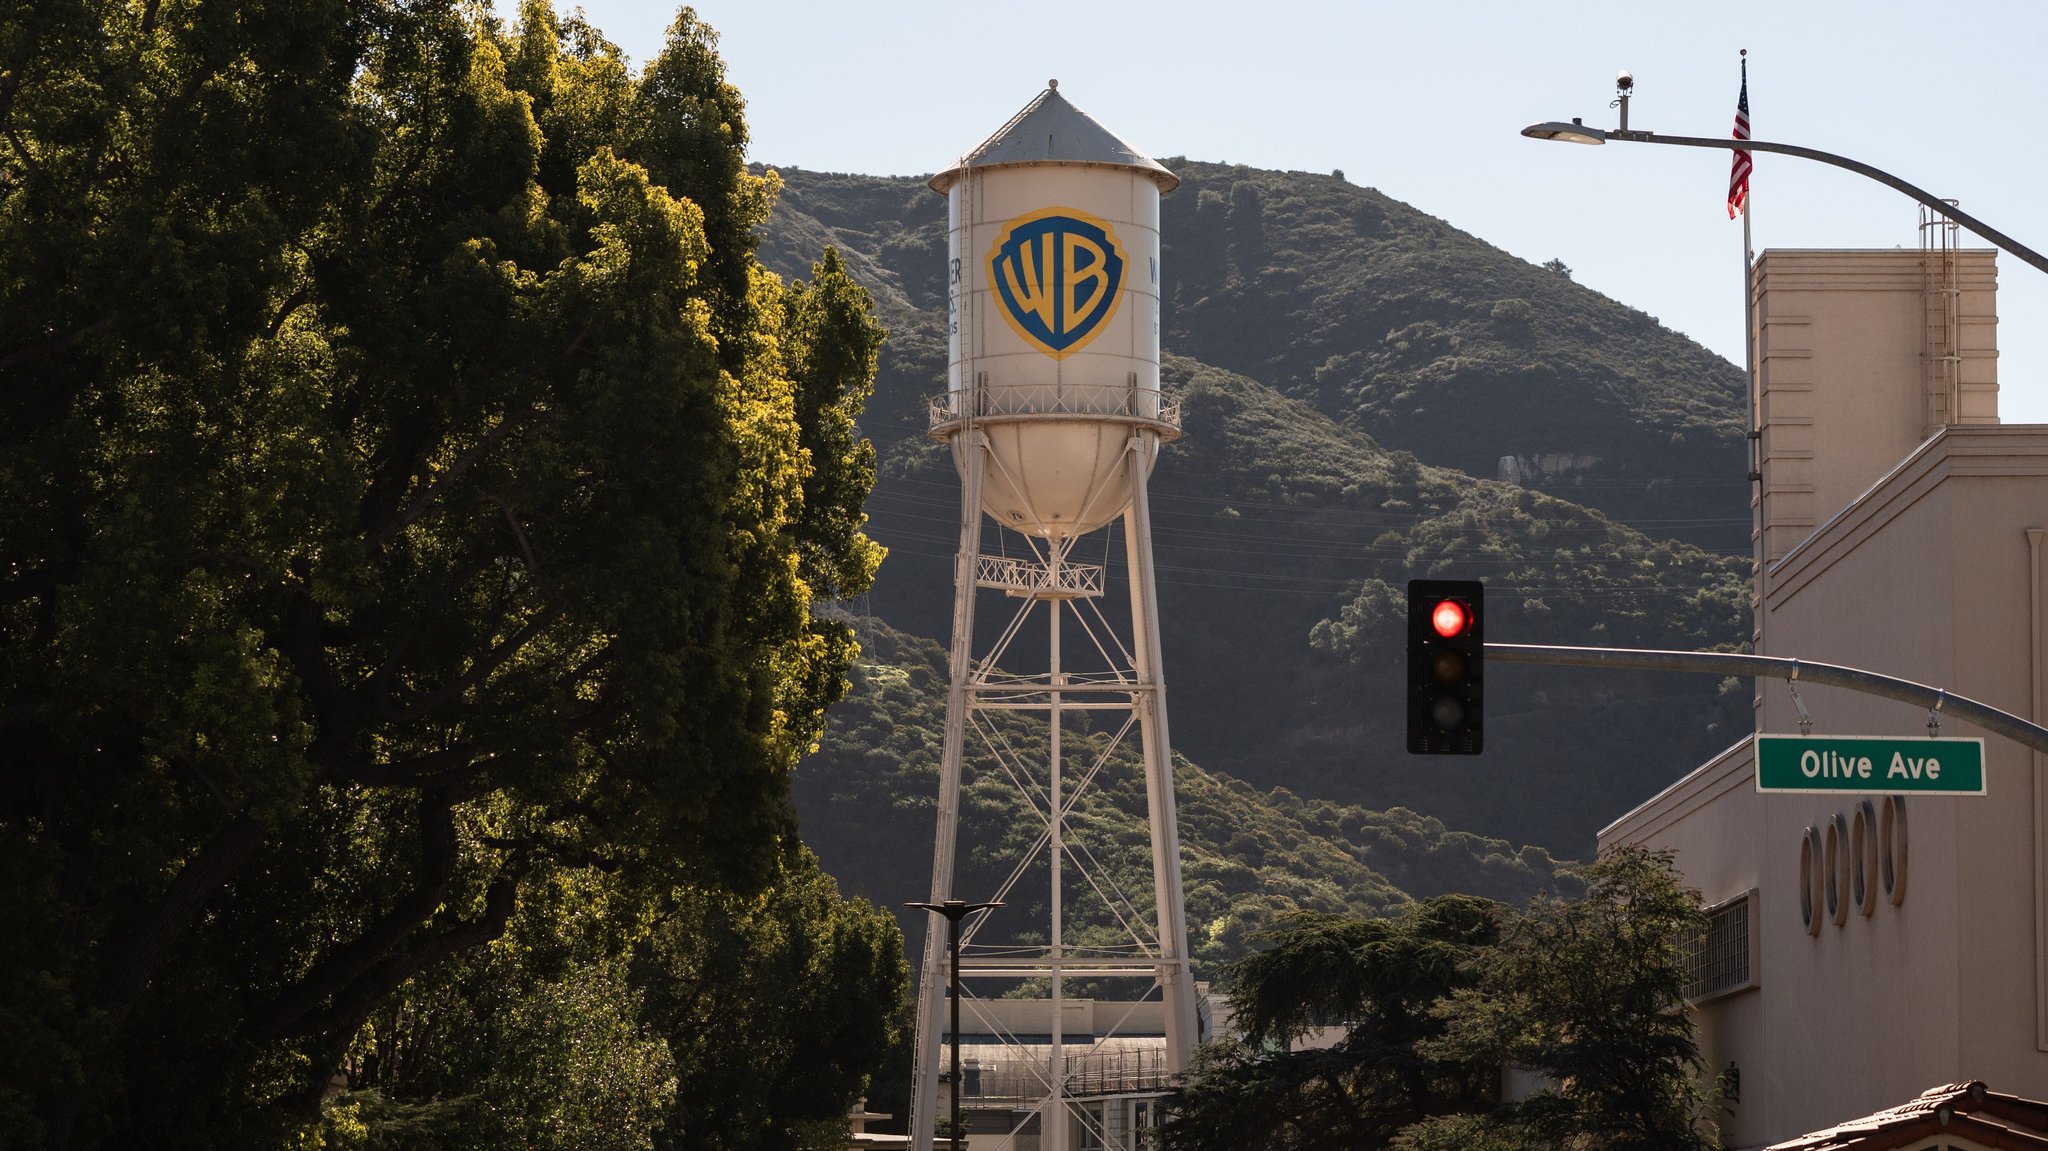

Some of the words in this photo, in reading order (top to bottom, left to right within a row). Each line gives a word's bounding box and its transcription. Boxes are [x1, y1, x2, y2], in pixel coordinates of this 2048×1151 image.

[1002, 232, 1109, 335] WB
[1801, 750, 1872, 779] Olive
[1887, 751, 1941, 780] Ave
